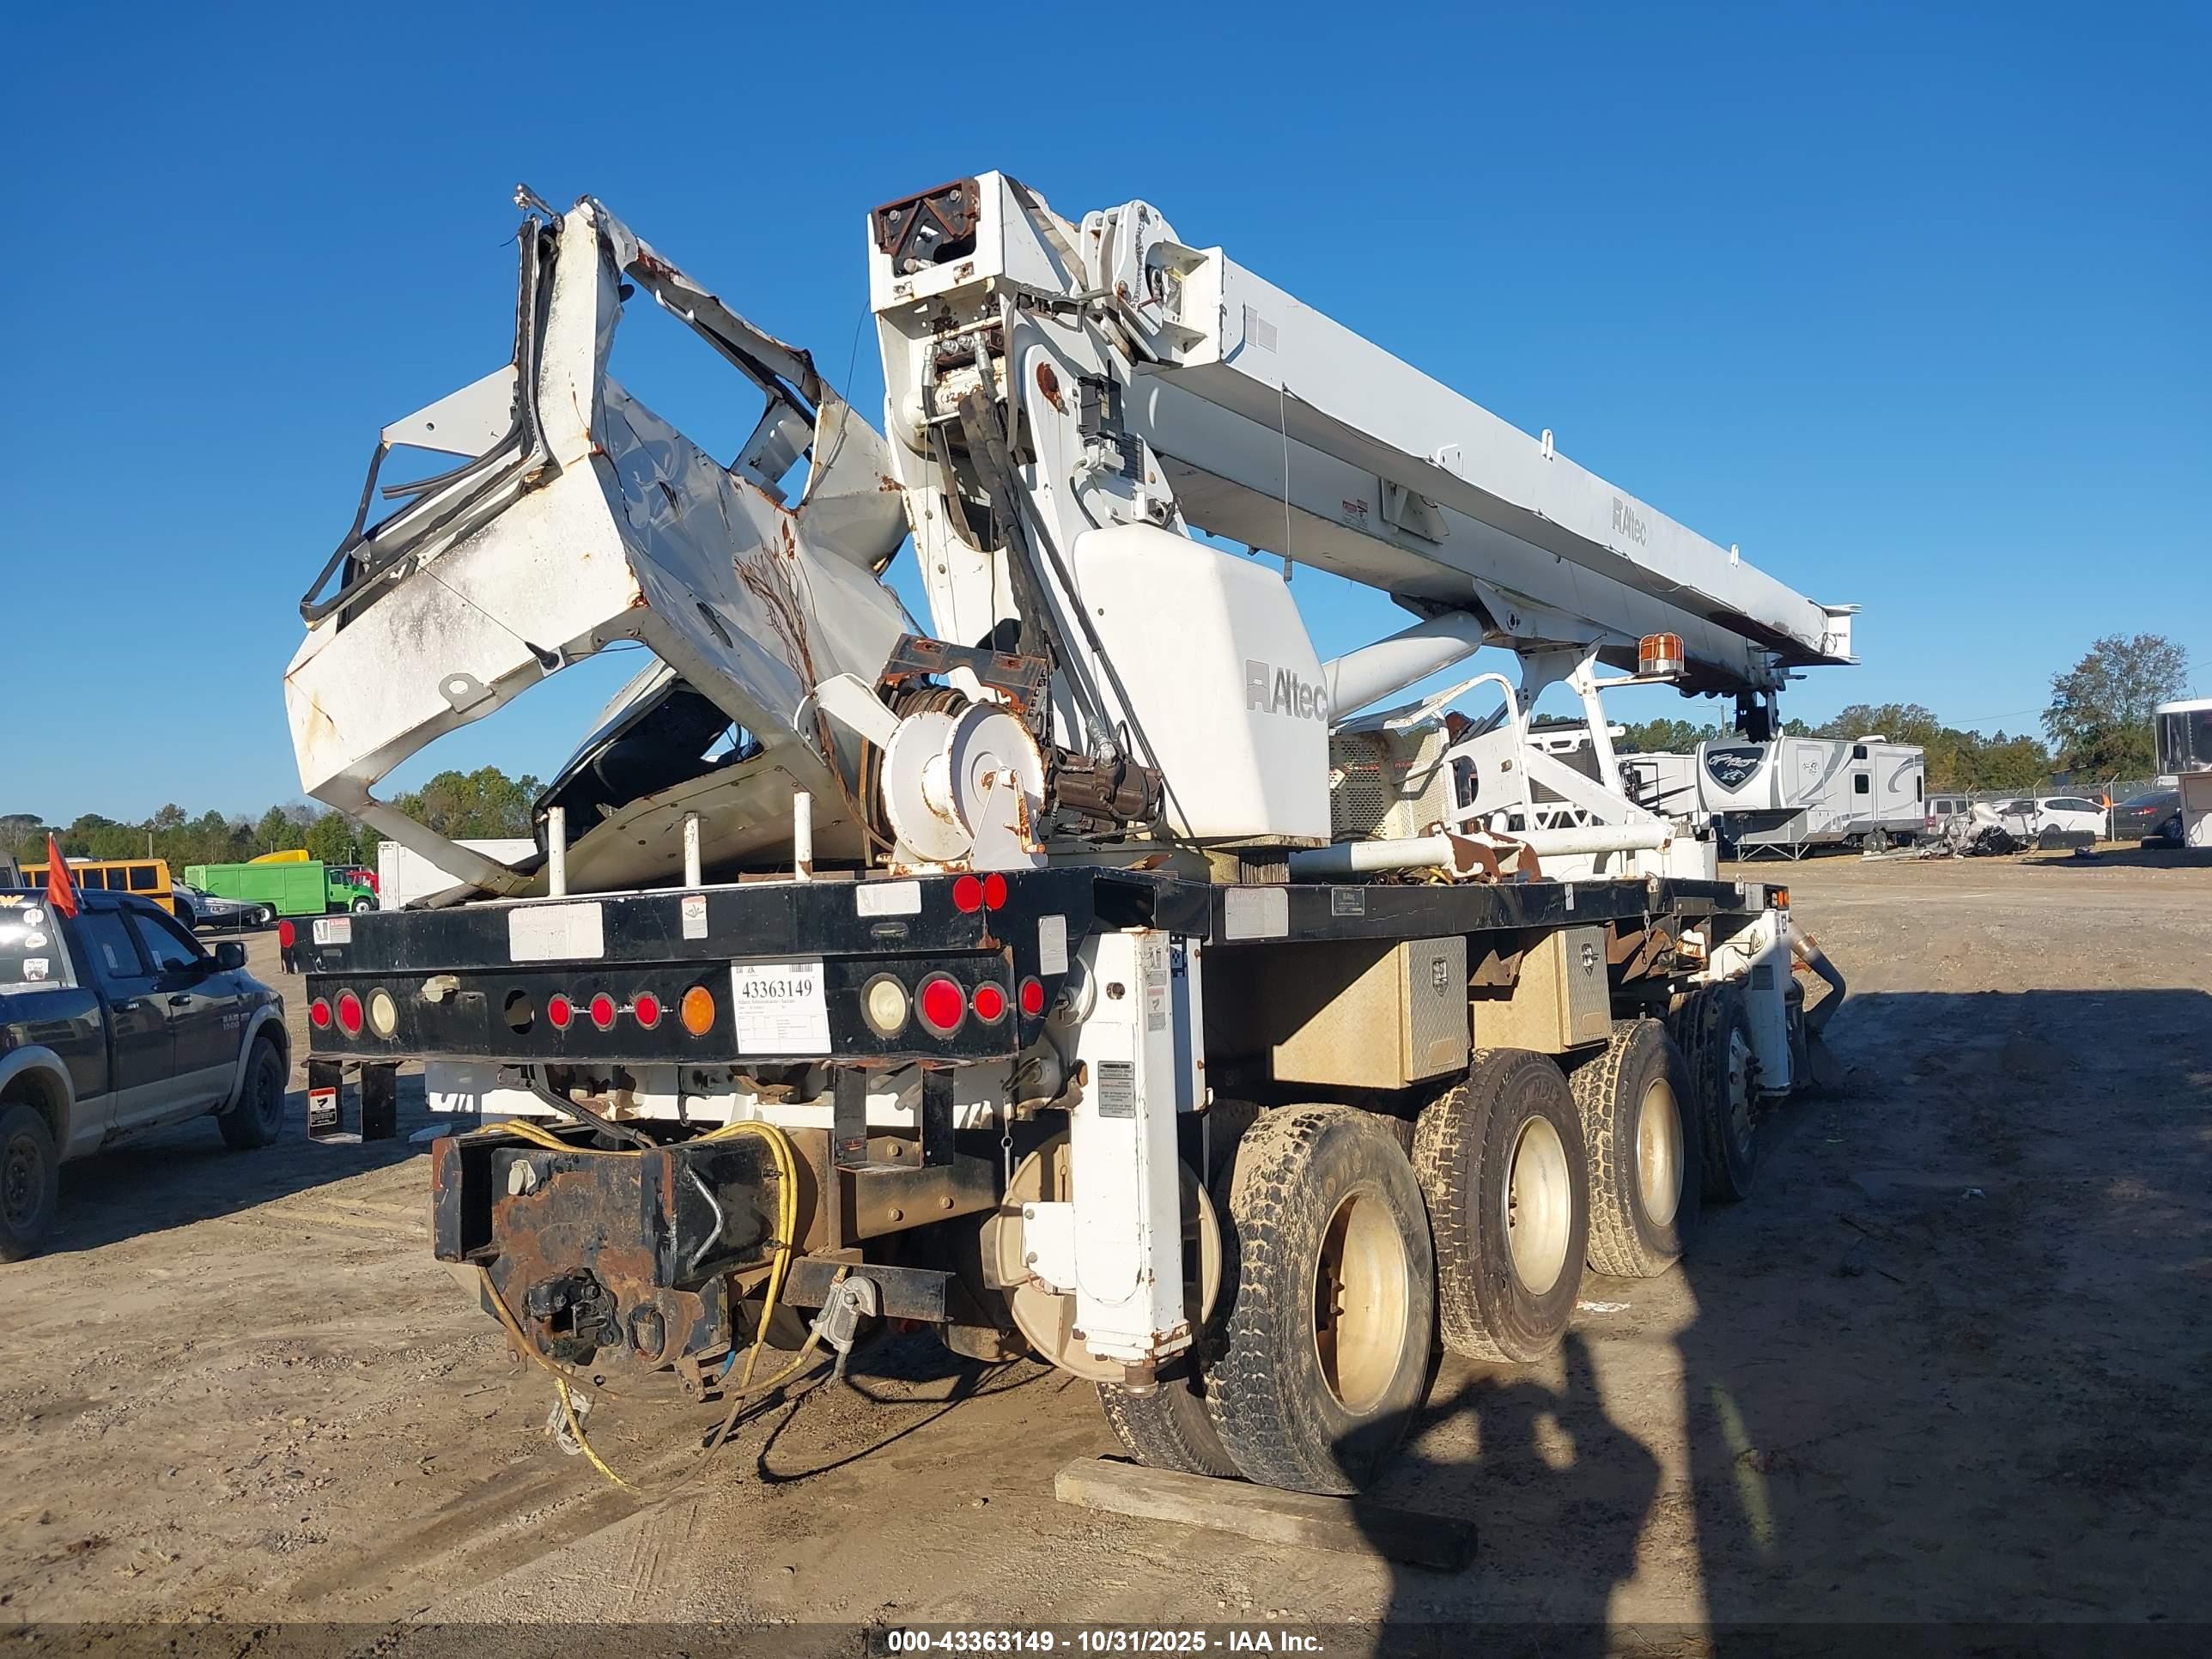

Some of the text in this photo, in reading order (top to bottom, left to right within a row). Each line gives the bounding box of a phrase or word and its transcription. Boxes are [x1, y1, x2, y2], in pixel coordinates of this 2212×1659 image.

[1622, 504, 1647, 547] Altec
[1271, 666, 1328, 722] Altec
[742, 979, 813, 999] 43363149
